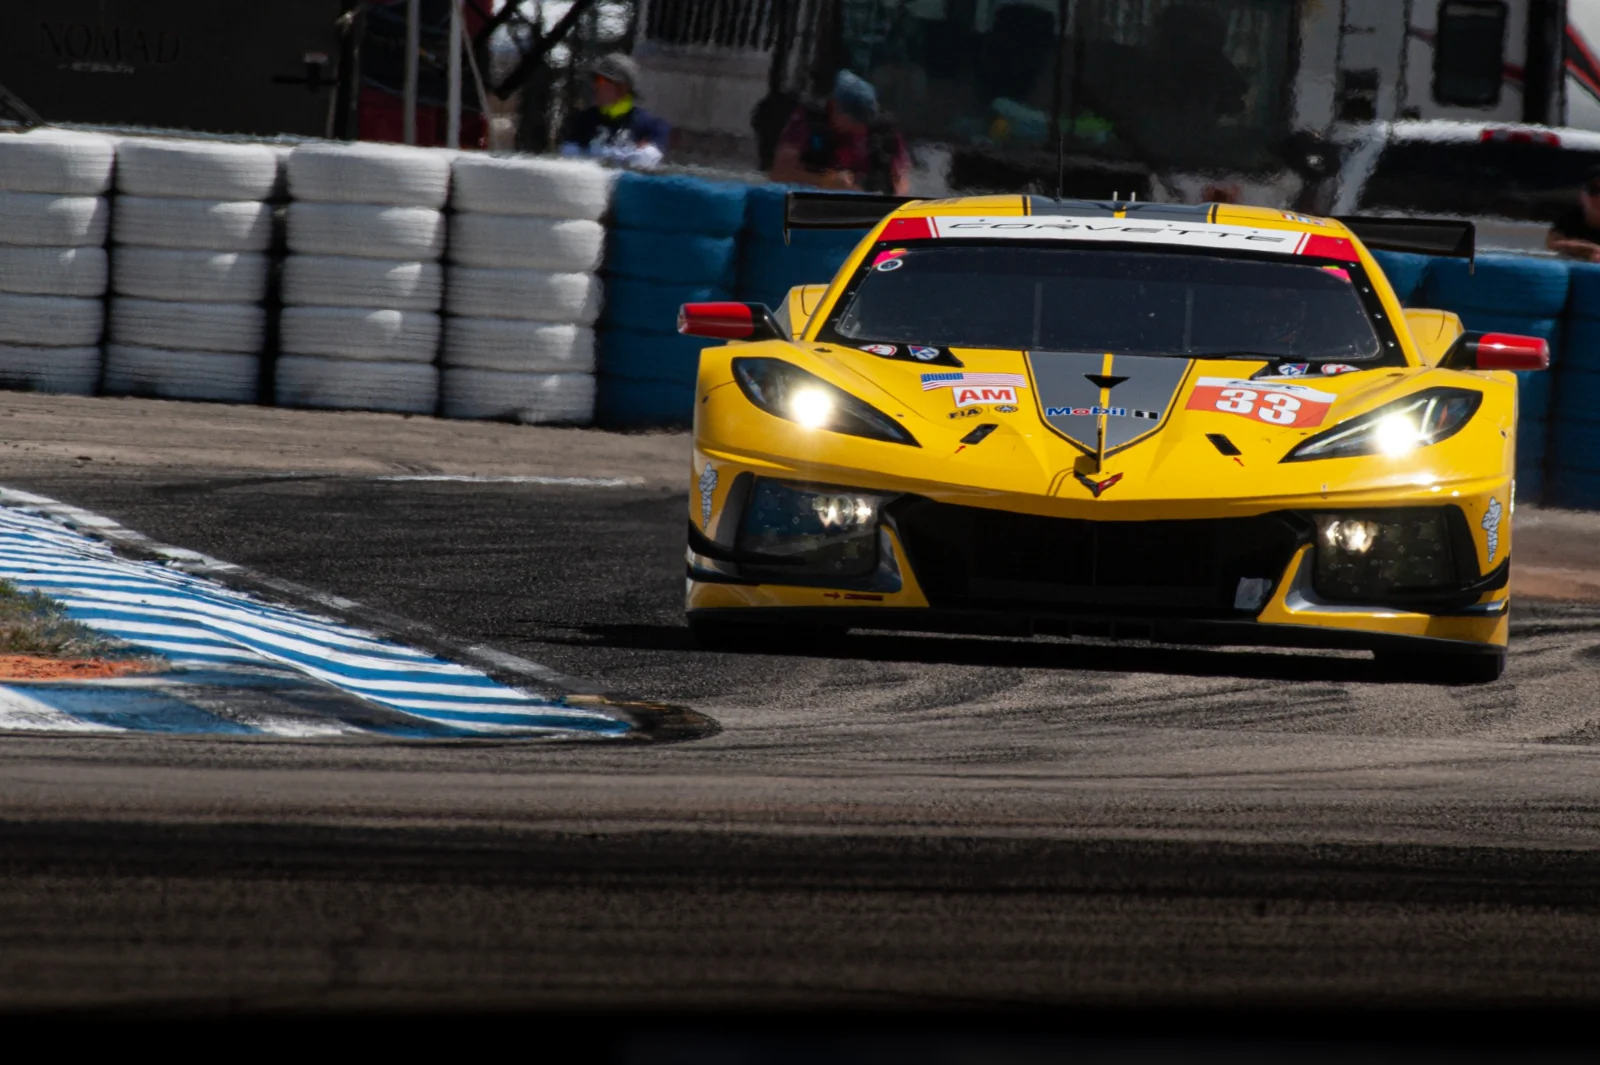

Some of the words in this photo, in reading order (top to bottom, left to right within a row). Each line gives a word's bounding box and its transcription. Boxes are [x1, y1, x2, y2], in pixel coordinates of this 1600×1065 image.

[39, 22, 182, 63] NOMAD
[948, 222, 1286, 243] CORVETTE
[958, 389, 1012, 403] AM
[1046, 406, 1125, 416] Mobil
[1215, 389, 1301, 425] 33
